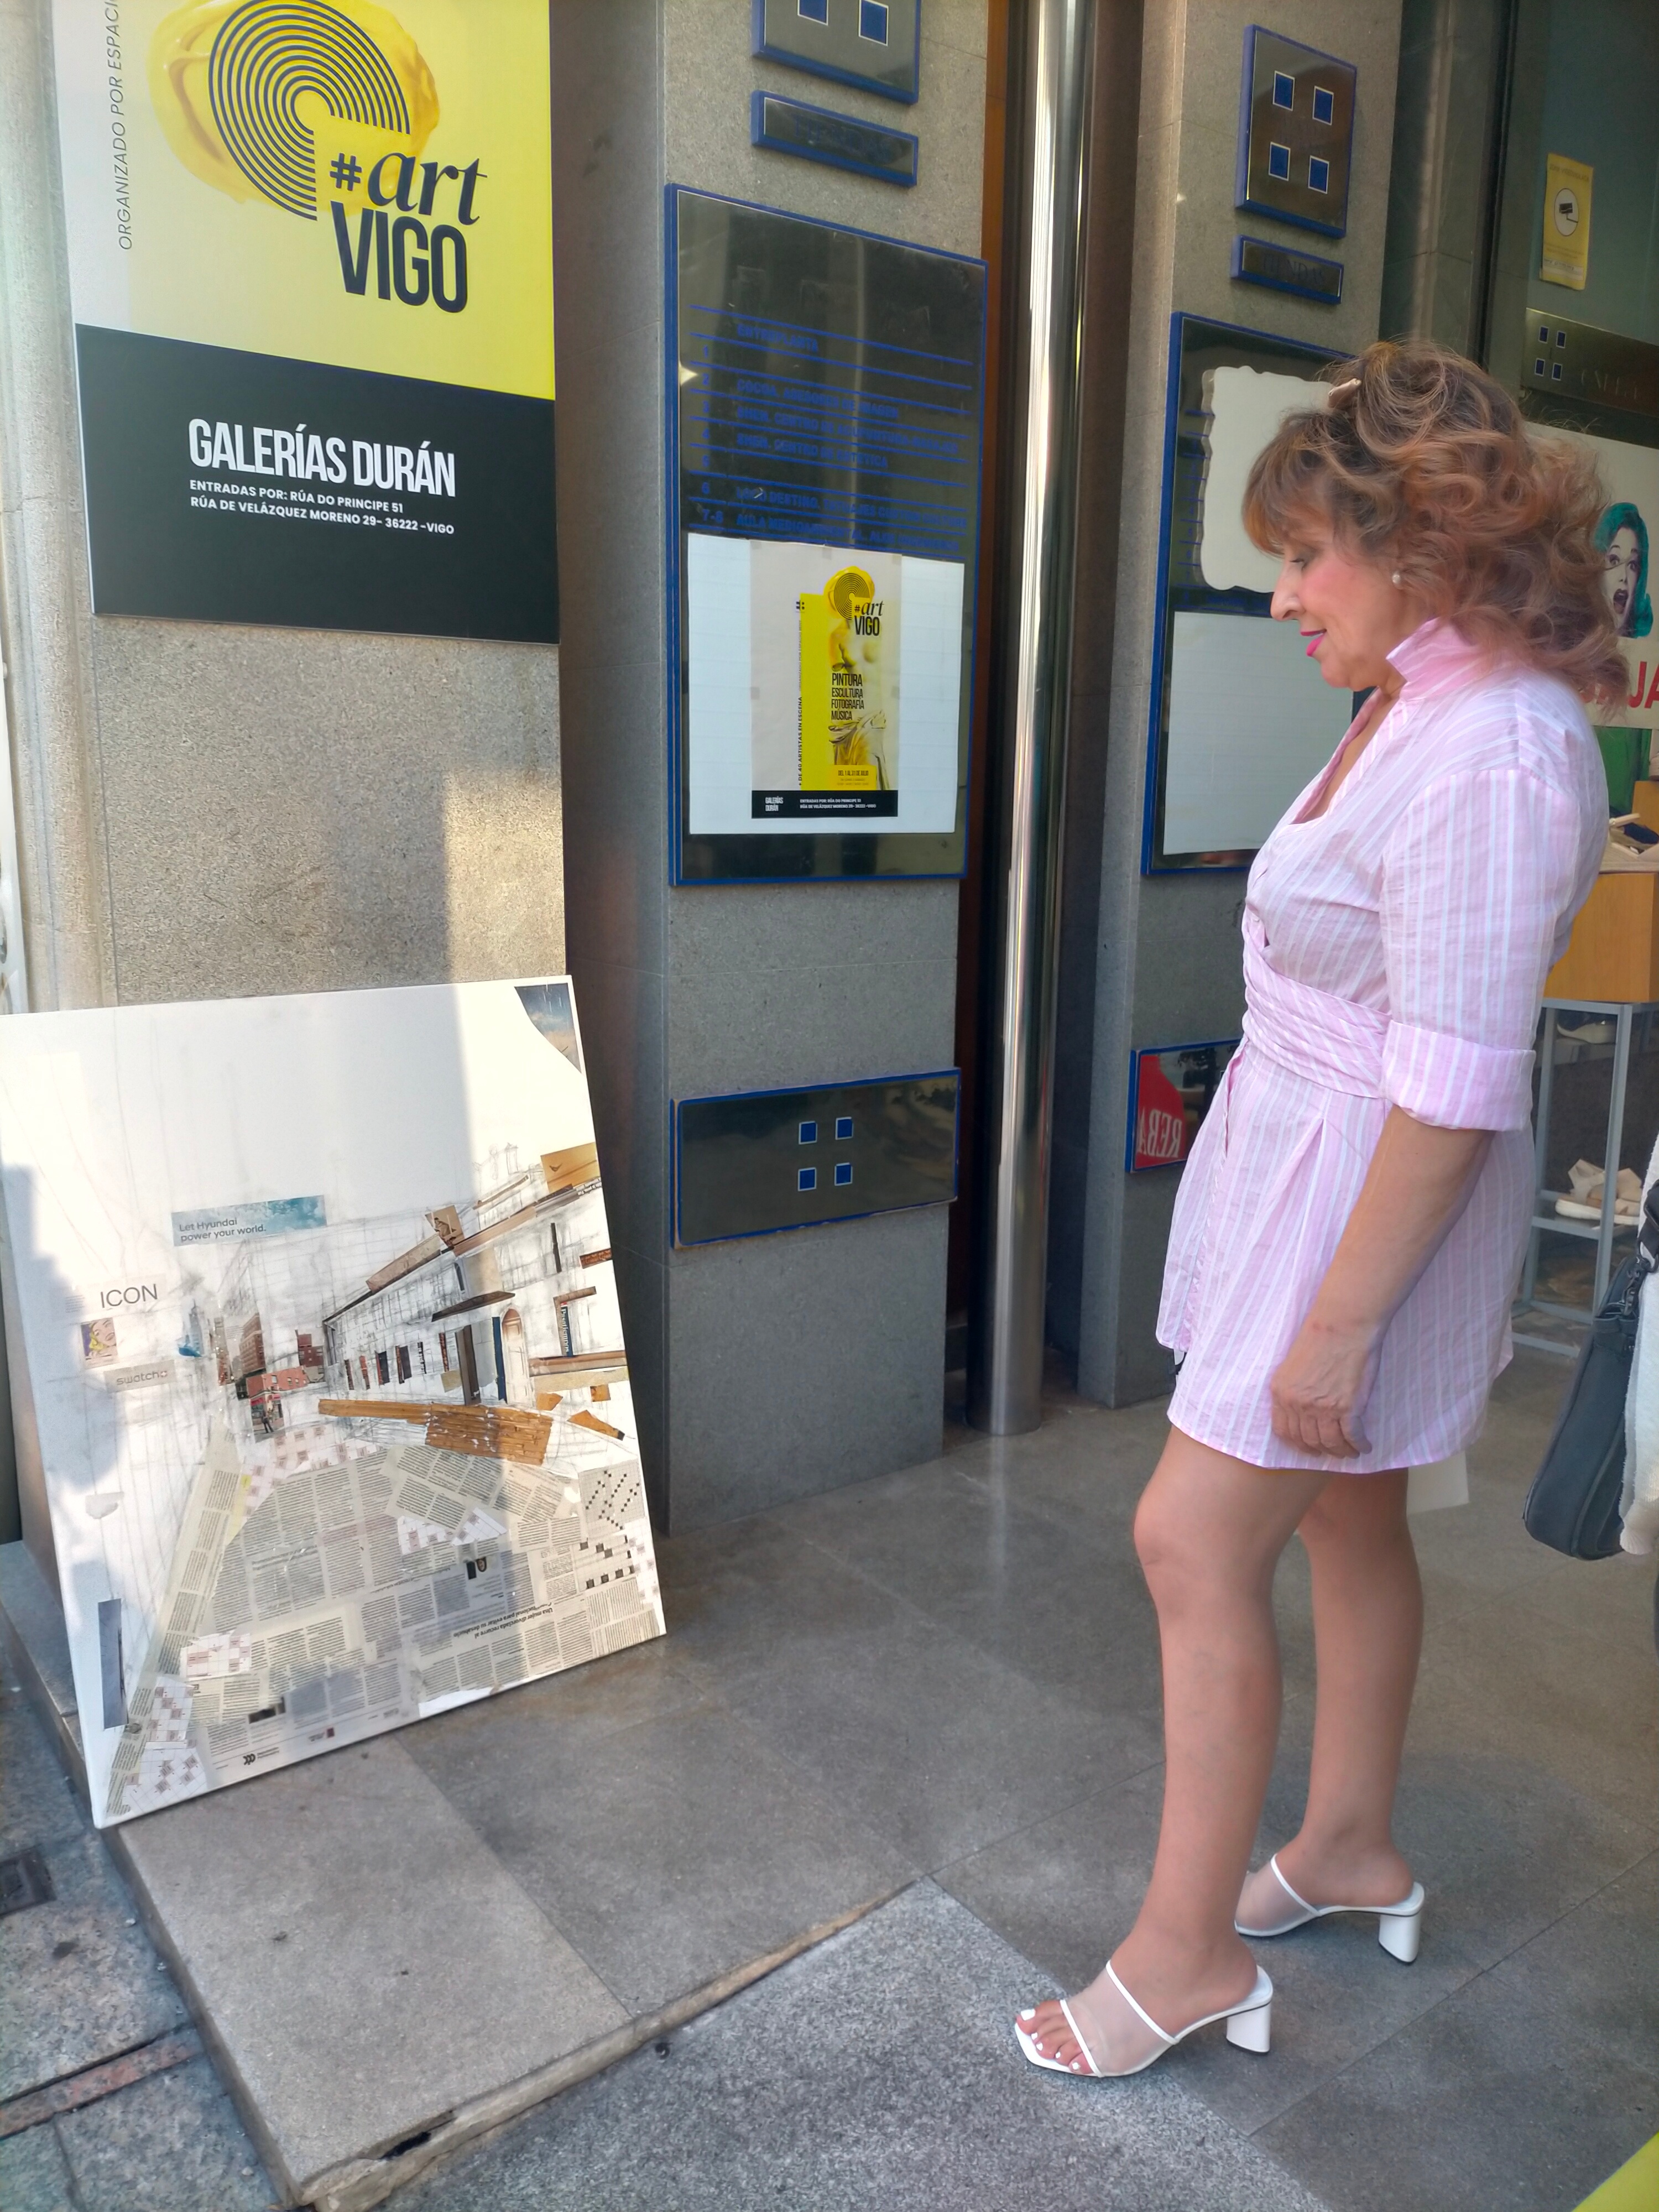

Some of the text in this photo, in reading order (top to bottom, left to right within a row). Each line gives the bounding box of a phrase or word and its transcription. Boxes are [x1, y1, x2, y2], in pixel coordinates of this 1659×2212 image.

[104, 0, 132, 250] ORGANIZADO POR ESPACI
[330, 152, 488, 226] #art
[330, 200, 468, 313] VIGO
[737, 323, 819, 352] ENTREPLANTA
[703, 344, 709, 358] 1
[702, 373, 709, 385] 2
[841, 398, 856, 412] DE
[702, 400, 710, 413] 3
[775, 413, 818, 431] CENTRO
[820, 420, 834, 434] DE
[701, 427, 711, 440] 4
[774, 439, 818, 457] CENTRO
[820, 447, 834, 460] DE
[836, 448, 888, 468] ESTETICA
[189, 418, 456, 497] GALERÍAS DURÁN
[190, 479, 404, 513] ENTRADAS POR: RÚA DO PRINCIPE 51
[190, 494, 217, 509] RÚA
[220, 499, 236, 511] DE
[238, 501, 307, 519] VELÁZQUEZ
[310, 509, 361, 525] MORENO
[385, 518, 418, 531] 36222
[702, 508, 724, 524] 7-8
[736, 514, 765, 529] AULA
[854, 600, 884, 617] #art
[854, 615, 880, 637] VIGO
[832, 672, 863, 687] PINTURA
[832, 687, 864, 698] ESCULTURA
[831, 708, 853, 721] MÚSICA
[798, 723, 802, 731] EN
[798, 773, 802, 781] DE
[765, 796, 784, 804] GALERÍAS
[179, 1217, 238, 1232] Let Hyundai
[181, 1224, 267, 1243] power your world.
[100, 1284, 159, 1309] ICON
[561, 1308, 570, 1353] Pasatiempos
[116, 1371, 160, 1385] swatch
[487, 1618, 503, 1627] evitar
[500, 1616, 528, 1628] divorciada
[527, 1610, 542, 1620] mujer
[453, 1625, 480, 1638] desahucio
[480, 1625, 499, 1636] recurre
